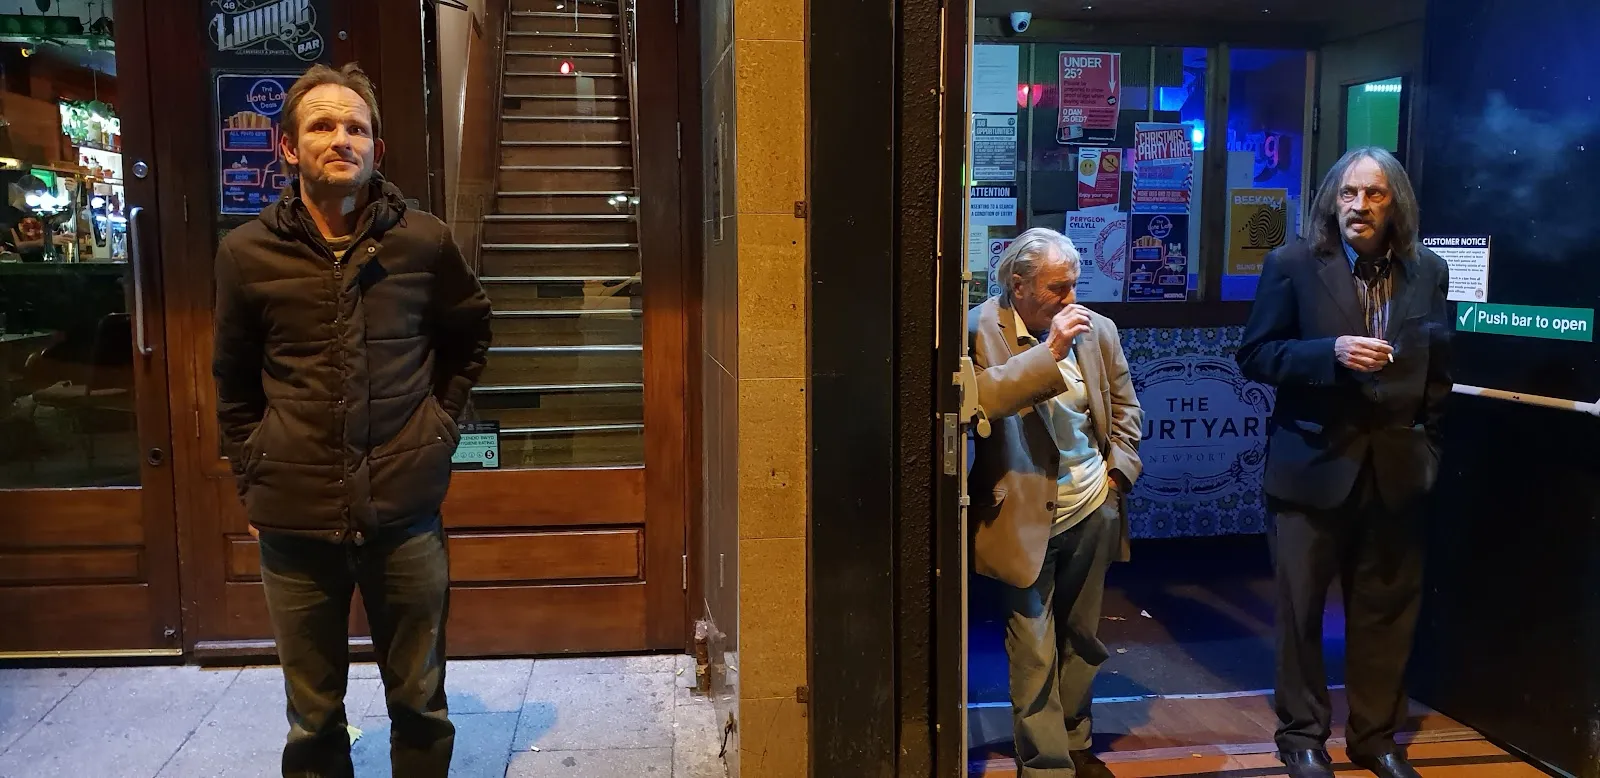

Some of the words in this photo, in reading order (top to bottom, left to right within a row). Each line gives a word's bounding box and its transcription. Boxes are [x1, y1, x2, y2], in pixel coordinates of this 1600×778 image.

[297, 39, 320, 53] BAR
[1063, 57, 1102, 68] UNDER
[1064, 68, 1082, 79] 25?
[246, 94, 266, 103] Late
[976, 127, 1013, 135] OPPORTUNITIES
[1139, 130, 1183, 146] CHRISTMAS
[1138, 143, 1168, 160] PARTY
[1170, 141, 1191, 158] HIRE
[971, 187, 1010, 197] ATTENTION
[1422, 238, 1460, 246] CUSTOMER
[1461, 238, 1487, 246] NOTICE
[1478, 311, 1508, 325] Push
[1511, 313, 1531, 327] bar
[1536, 315, 1549, 329] to
[1552, 318, 1587, 333] open
[1166, 397, 1209, 413] THE
[1141, 417, 1273, 440] URTYAR
[1149, 452, 1226, 464] NEWPORT
